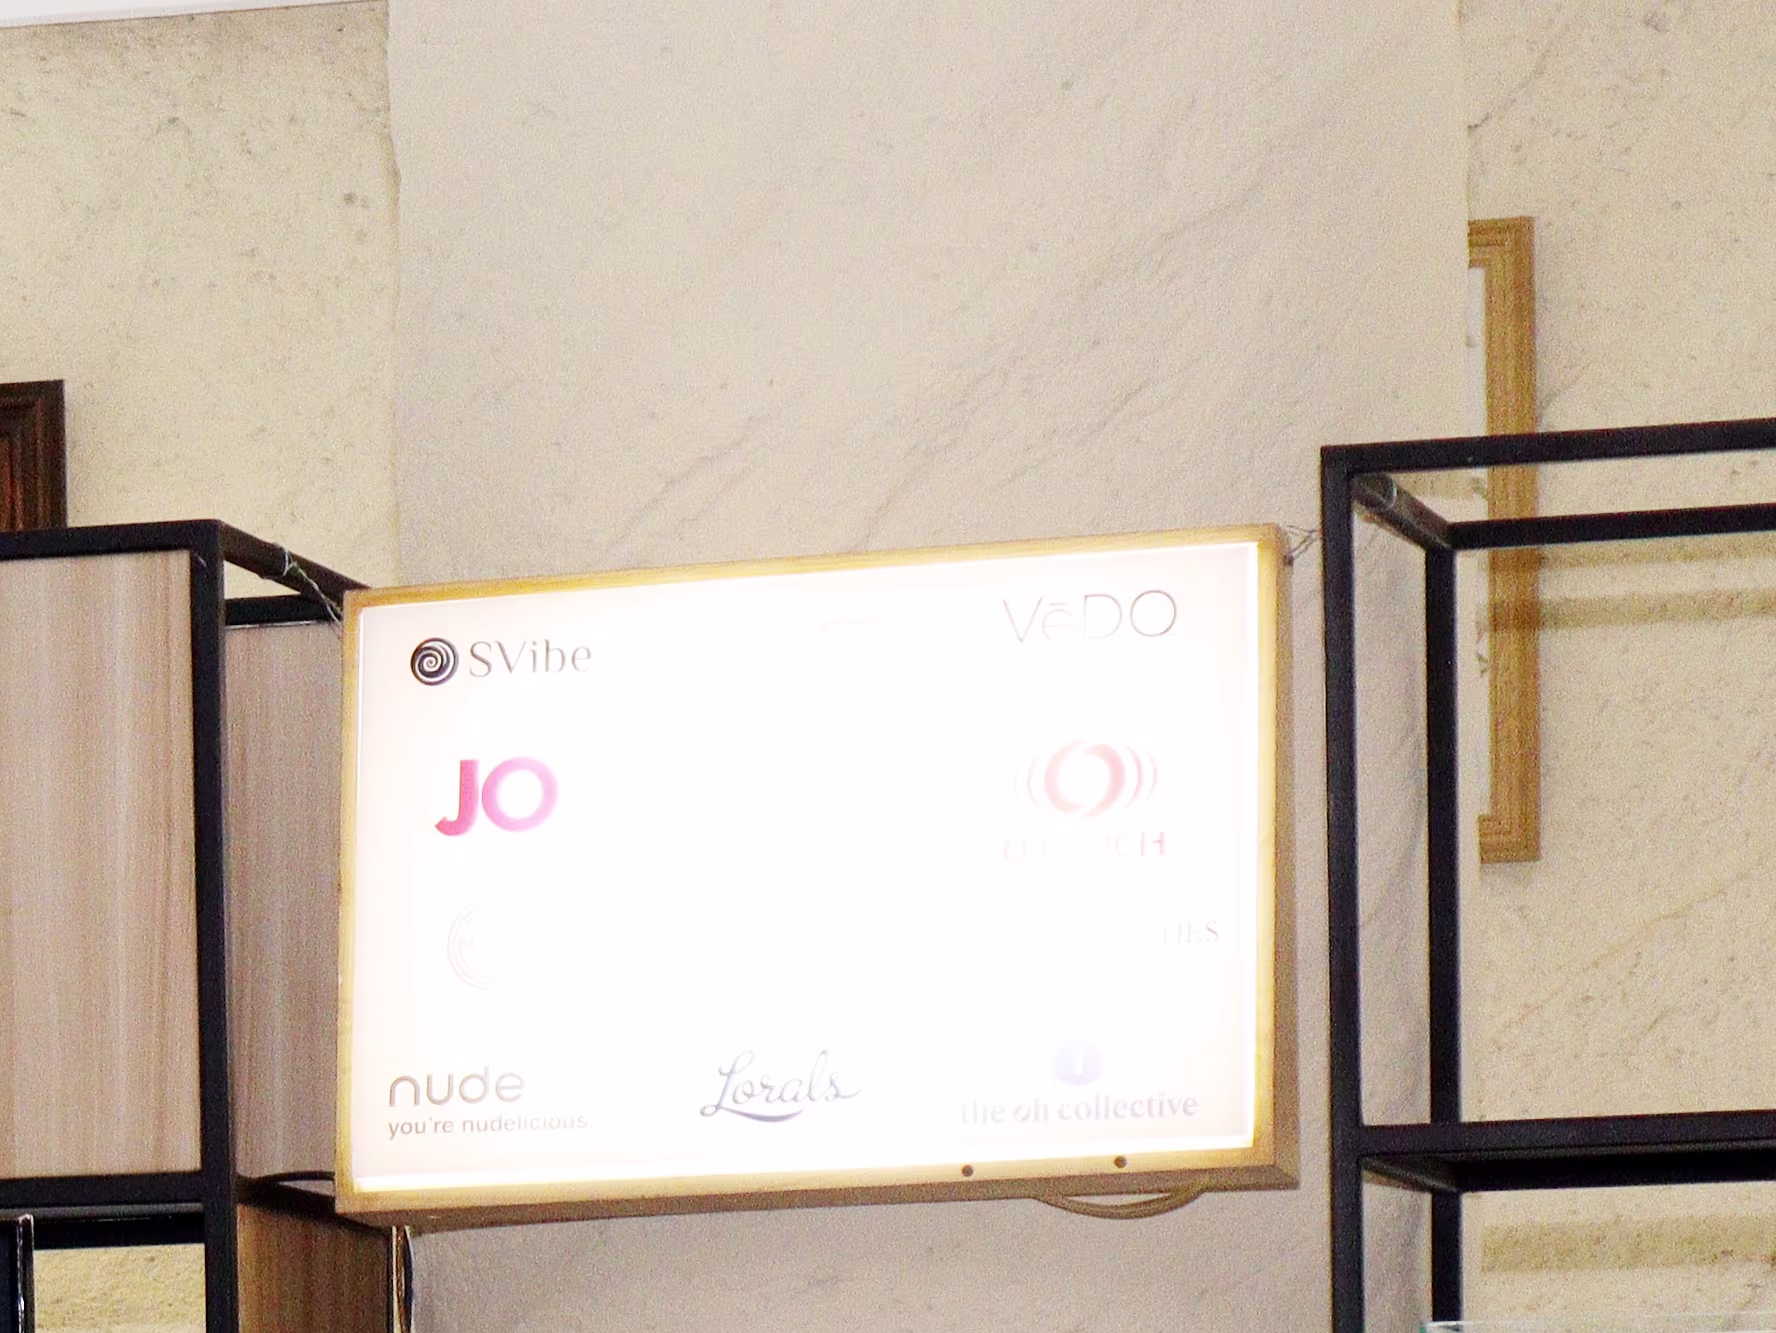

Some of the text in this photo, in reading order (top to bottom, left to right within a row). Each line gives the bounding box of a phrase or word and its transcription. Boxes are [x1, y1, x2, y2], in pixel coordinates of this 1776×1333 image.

[467, 636, 594, 680] SVibe
[433, 755, 560, 838] JO
[388, 1064, 526, 1108] nude
[1057, 1090, 1201, 1122] collective
[387, 1116, 454, 1141] you're
